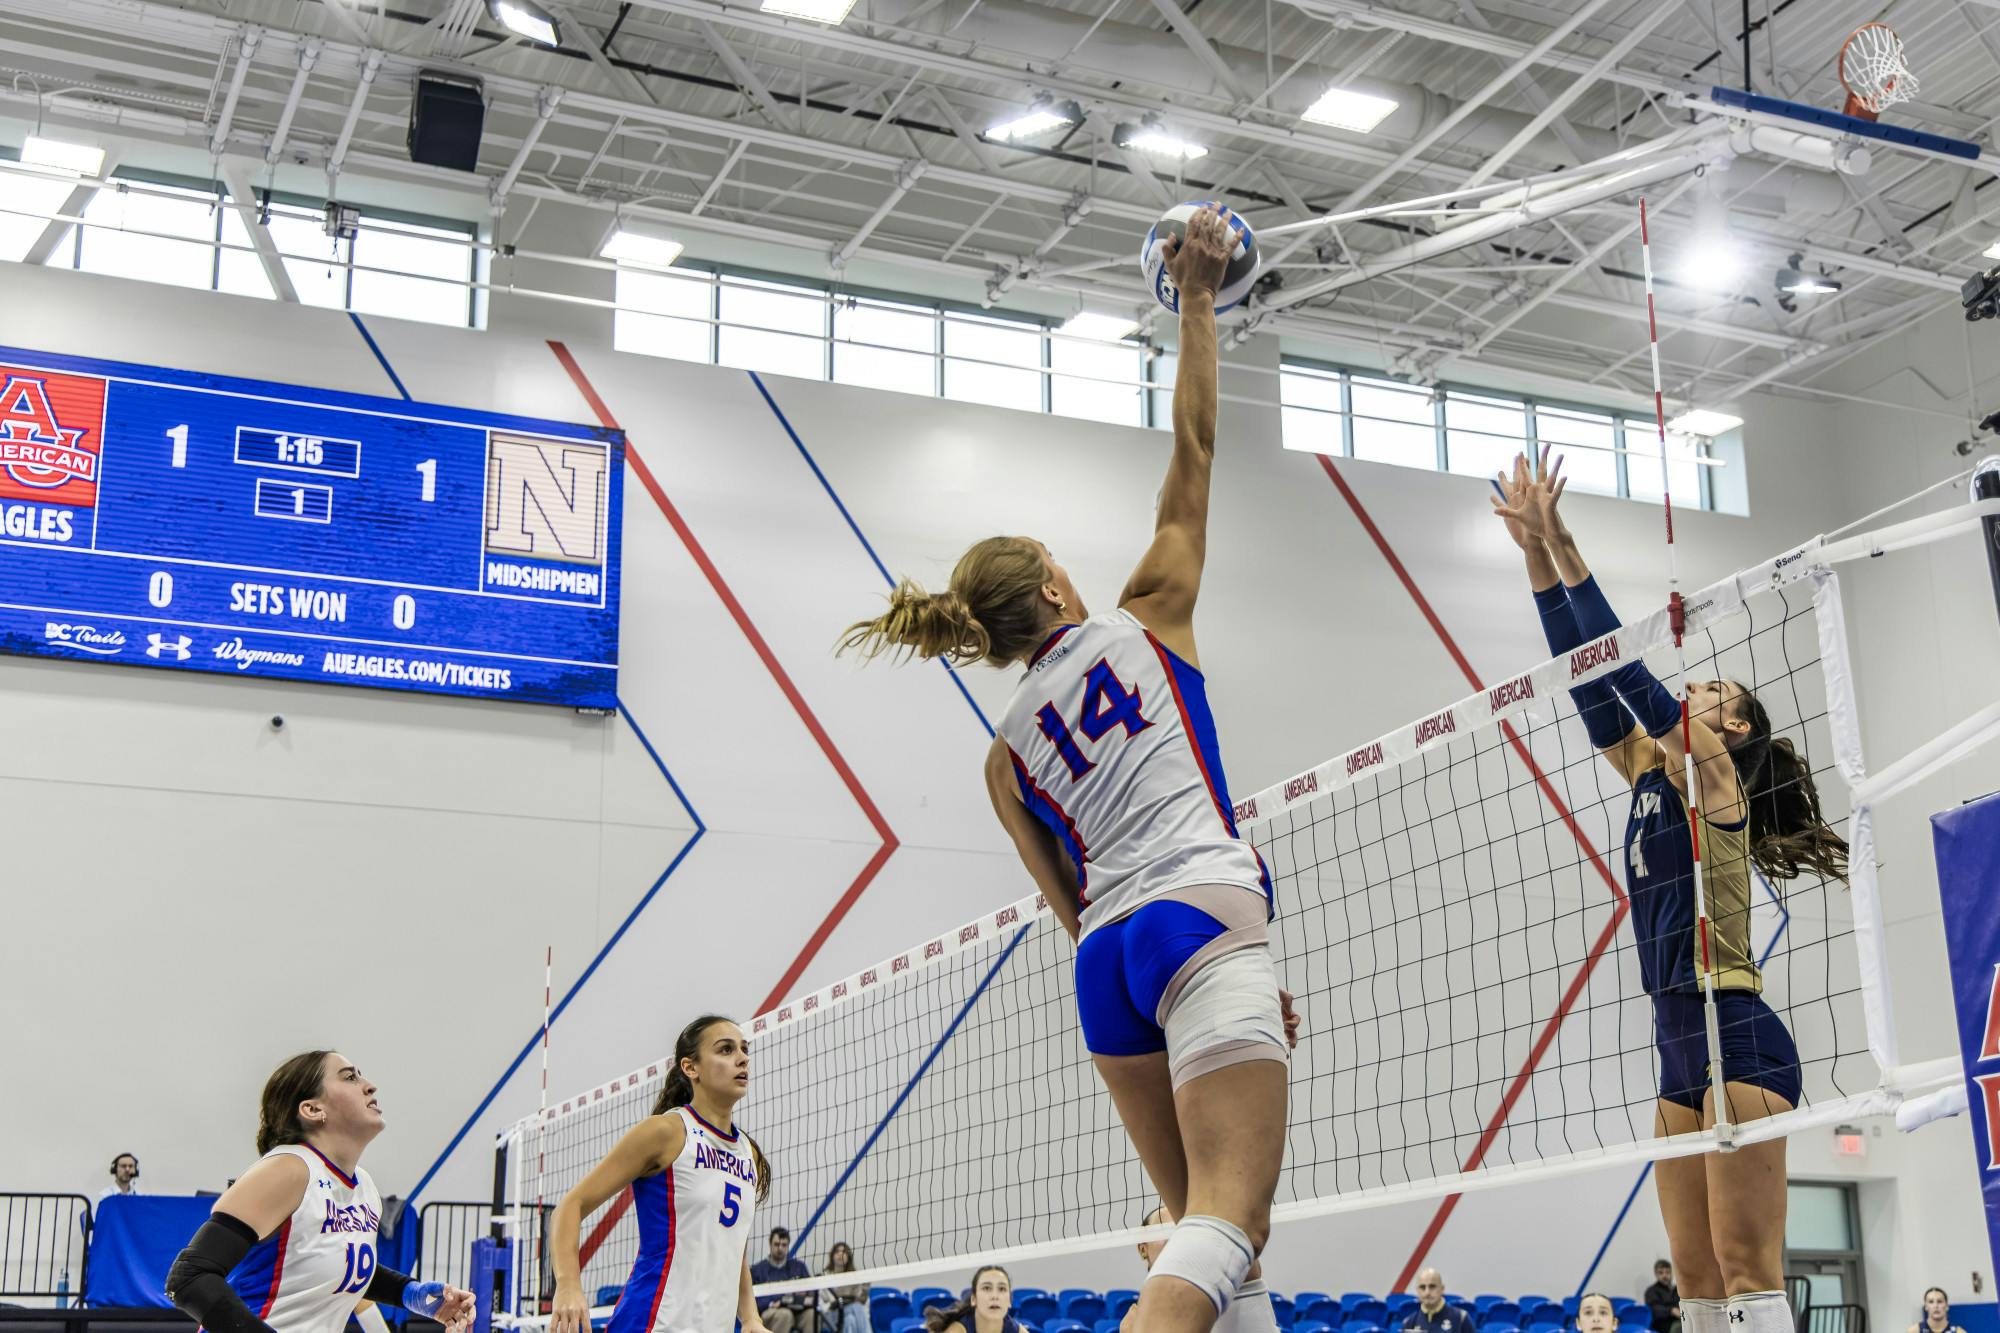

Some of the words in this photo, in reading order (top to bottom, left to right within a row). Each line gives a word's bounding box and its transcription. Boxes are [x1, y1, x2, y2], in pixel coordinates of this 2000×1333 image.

[0, 444, 90, 473] ERICAN
[166, 424, 188, 468] 1
[274, 435, 324, 466] 1:15
[416, 458, 437, 502] 1
[291, 488, 305, 515] 1
[0, 503, 74, 543] GLES
[148, 571, 174, 608] 0
[487, 562, 600, 596] MIDSHIPMEN
[230, 582, 285, 616] SETS
[290, 587, 347, 623] WON
[393, 594, 416, 631] 0
[73, 625, 127, 646] Trails
[212, 637, 305, 670] Wegmans
[322, 652, 512, 690] AUEAGLES.COM/TICKETS
[1571, 635, 1620, 679] AMERICAN
[1489, 674, 1535, 715] AMERICAN
[1034, 656, 1156, 784] 14
[1415, 709, 1456, 749] AMERICAN
[1346, 742, 1384, 778] AMERICAN
[1284, 771, 1318, 805] AMERICAN
[1630, 828, 1649, 878] 4
[718, 1181, 742, 1228] 5
[332, 1242, 375, 1294] 19
